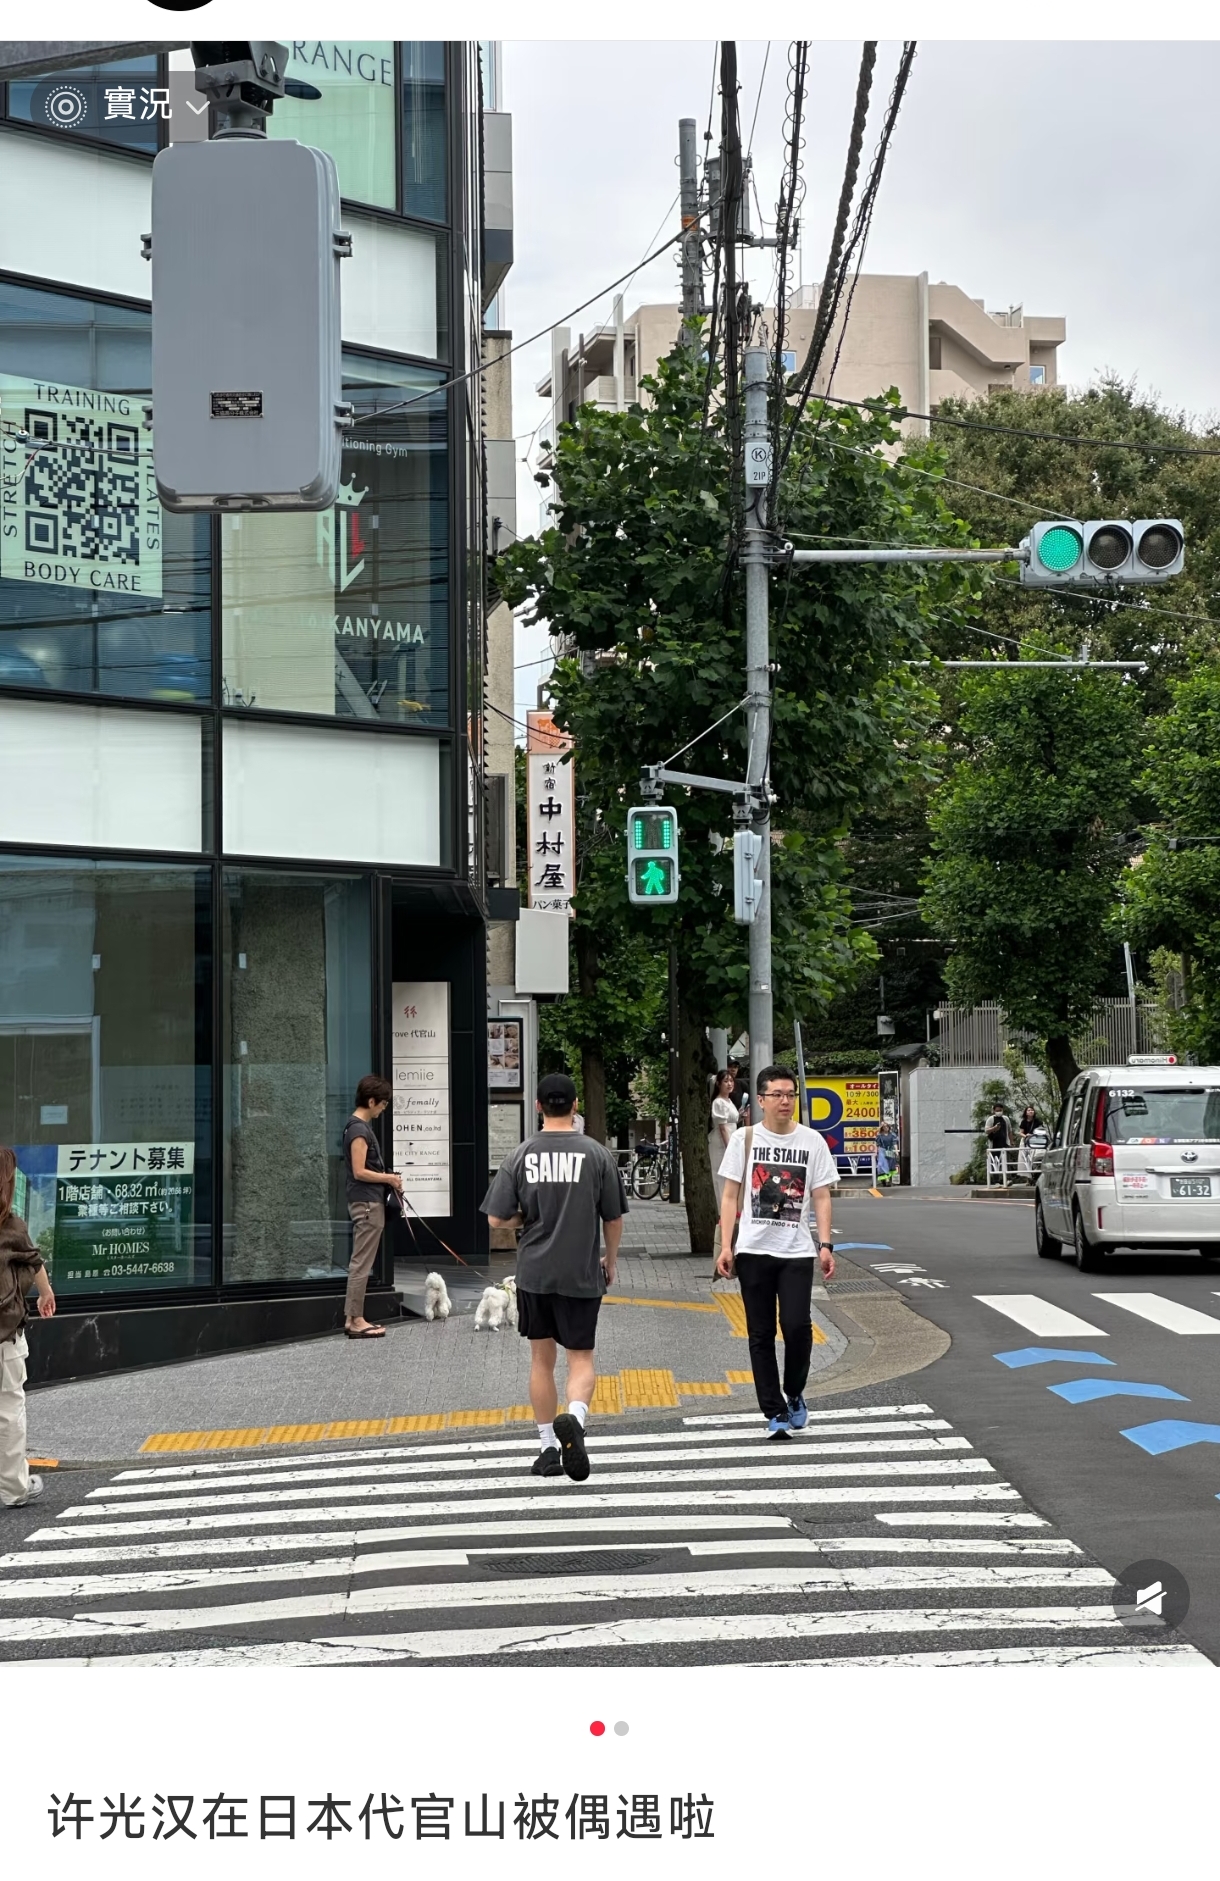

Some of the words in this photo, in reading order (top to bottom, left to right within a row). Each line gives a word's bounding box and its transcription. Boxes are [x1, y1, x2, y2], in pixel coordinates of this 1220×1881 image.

[293, 41, 391, 86] RANGE
[34, 383, 130, 415] TRAINING
[385, 443, 408, 458] Gym
[3, 421, 17, 537] STRETCH
[25, 561, 80, 583] BODY
[90, 570, 141, 592] CARE
[543, 762, 556, 790] 新宿
[534, 796, 565, 888] 中村屋
[411, 1029, 436, 1038] 代官山
[396, 1069, 434, 1081] lemiie
[1109, 1089, 1135, 1097] 6132
[405, 1097, 439, 1109] femally
[69, 1146, 185, 1172] テナント募集
[753, 1147, 771, 1162] THE
[773, 1148, 810, 1165] STALIN
[525, 1152, 586, 1184] SAINT
[1180, 1185, 1211, 1196] 61-32
[92, 1244, 107, 1256] Mr
[109, 1242, 150, 1255] HOMES
[111, 1262, 175, 1276] 03-5447-6638
